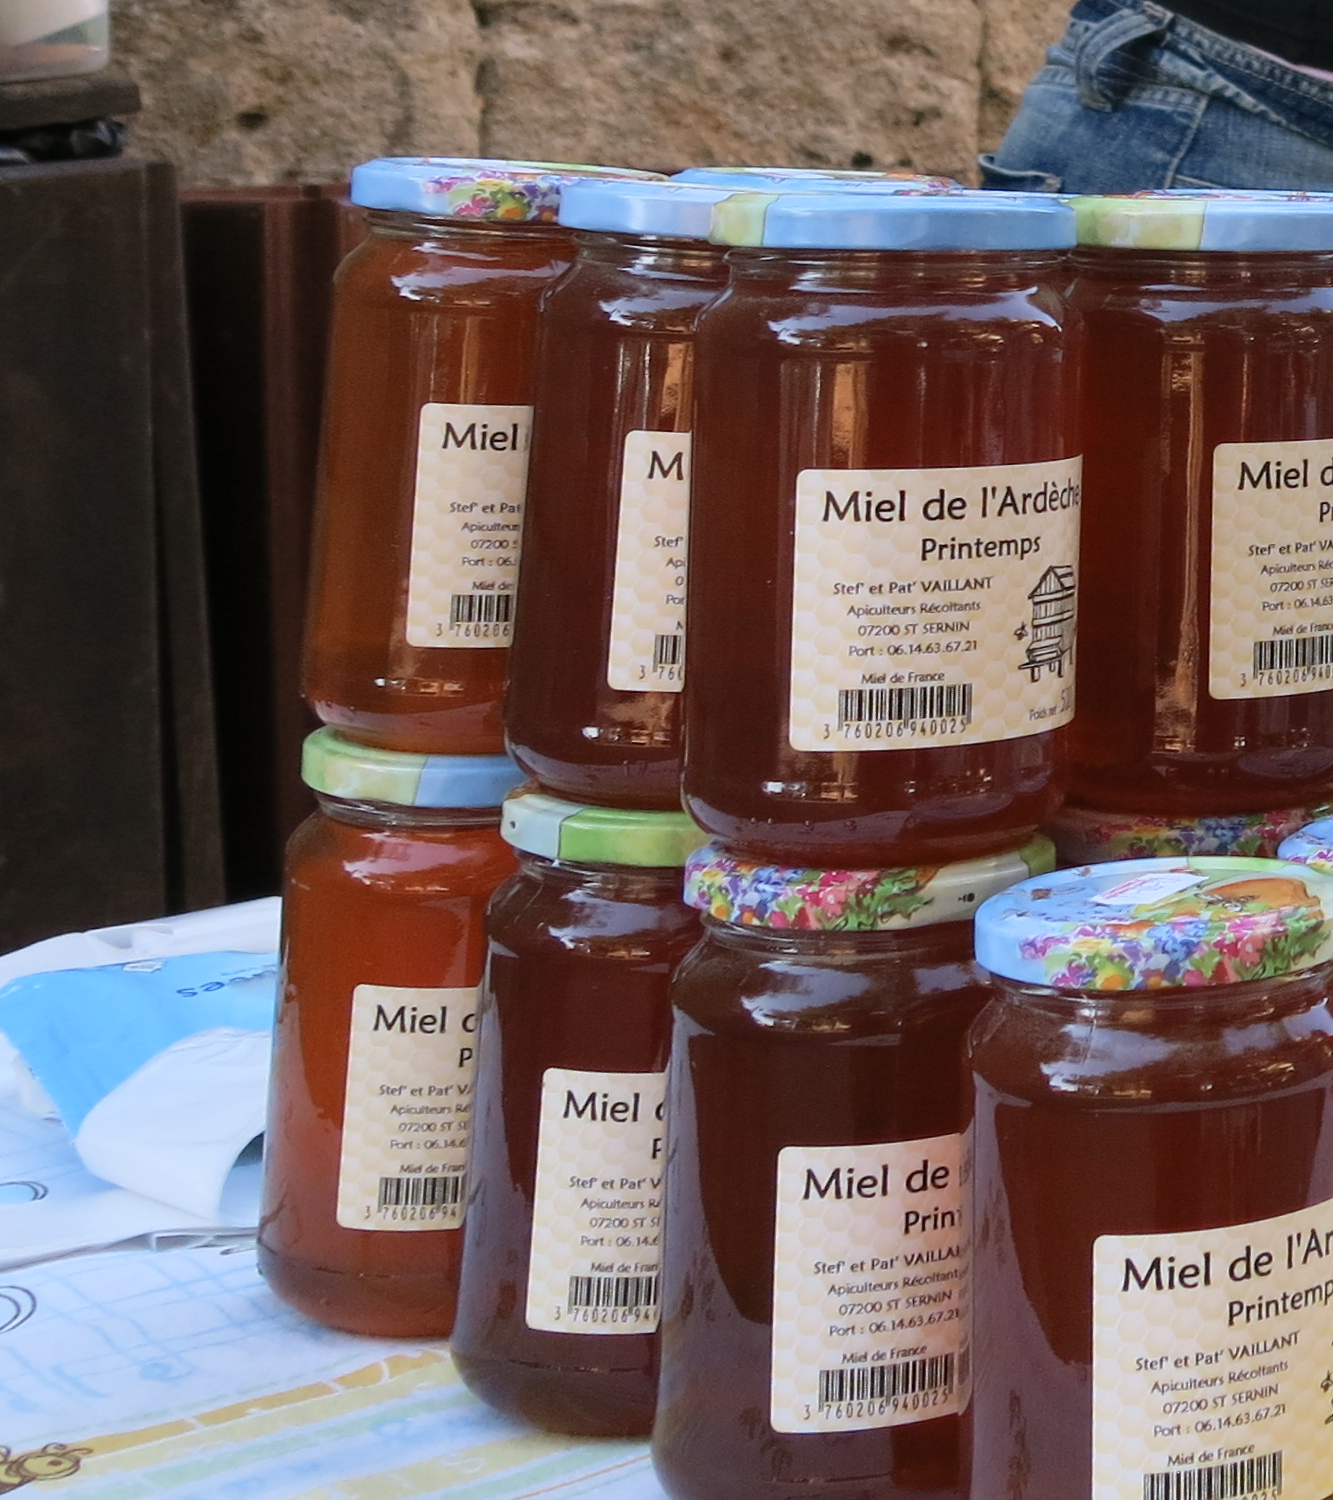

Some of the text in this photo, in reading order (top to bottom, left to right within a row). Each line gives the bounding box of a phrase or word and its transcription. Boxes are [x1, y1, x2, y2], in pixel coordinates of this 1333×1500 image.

[442, 422, 518, 451] Miel
[1238, 459, 1308, 490] Miel
[822, 489, 906, 522] Miel
[923, 489, 966, 522] de
[921, 536, 1041, 561] Printemps
[833, 576, 993, 595] Stef' et Pat' VAILLANT
[847, 601, 981, 618] Apiculteurs Récoltants
[858, 622, 970, 636] 07200 ST SERNIN
[849, 641, 977, 657] Port 06.14.63.67.21
[862, 672, 945, 684] Miel de France
[373, 1005, 447, 1034] Miel
[563, 1090, 641, 1123] Miel
[803, 1160, 949, 1199] Miel de
[1122, 1252, 1211, 1292] Miel
[1229, 1246, 1273, 1282] de
[839, 1290, 952, 1316] 07200 ST SERNIN
[1136, 1330, 1300, 1371] Stef' et Pat' VAILLANT
[1151, 1362, 1288, 1394] Apiculteurs Récoltants
[1163, 1384, 1279, 1414] 07200 ST SERNIN
[1154, 1404, 1286, 1437] Port 06.14.63.67.21
[1168, 1443, 1255, 1467] Miel de France
